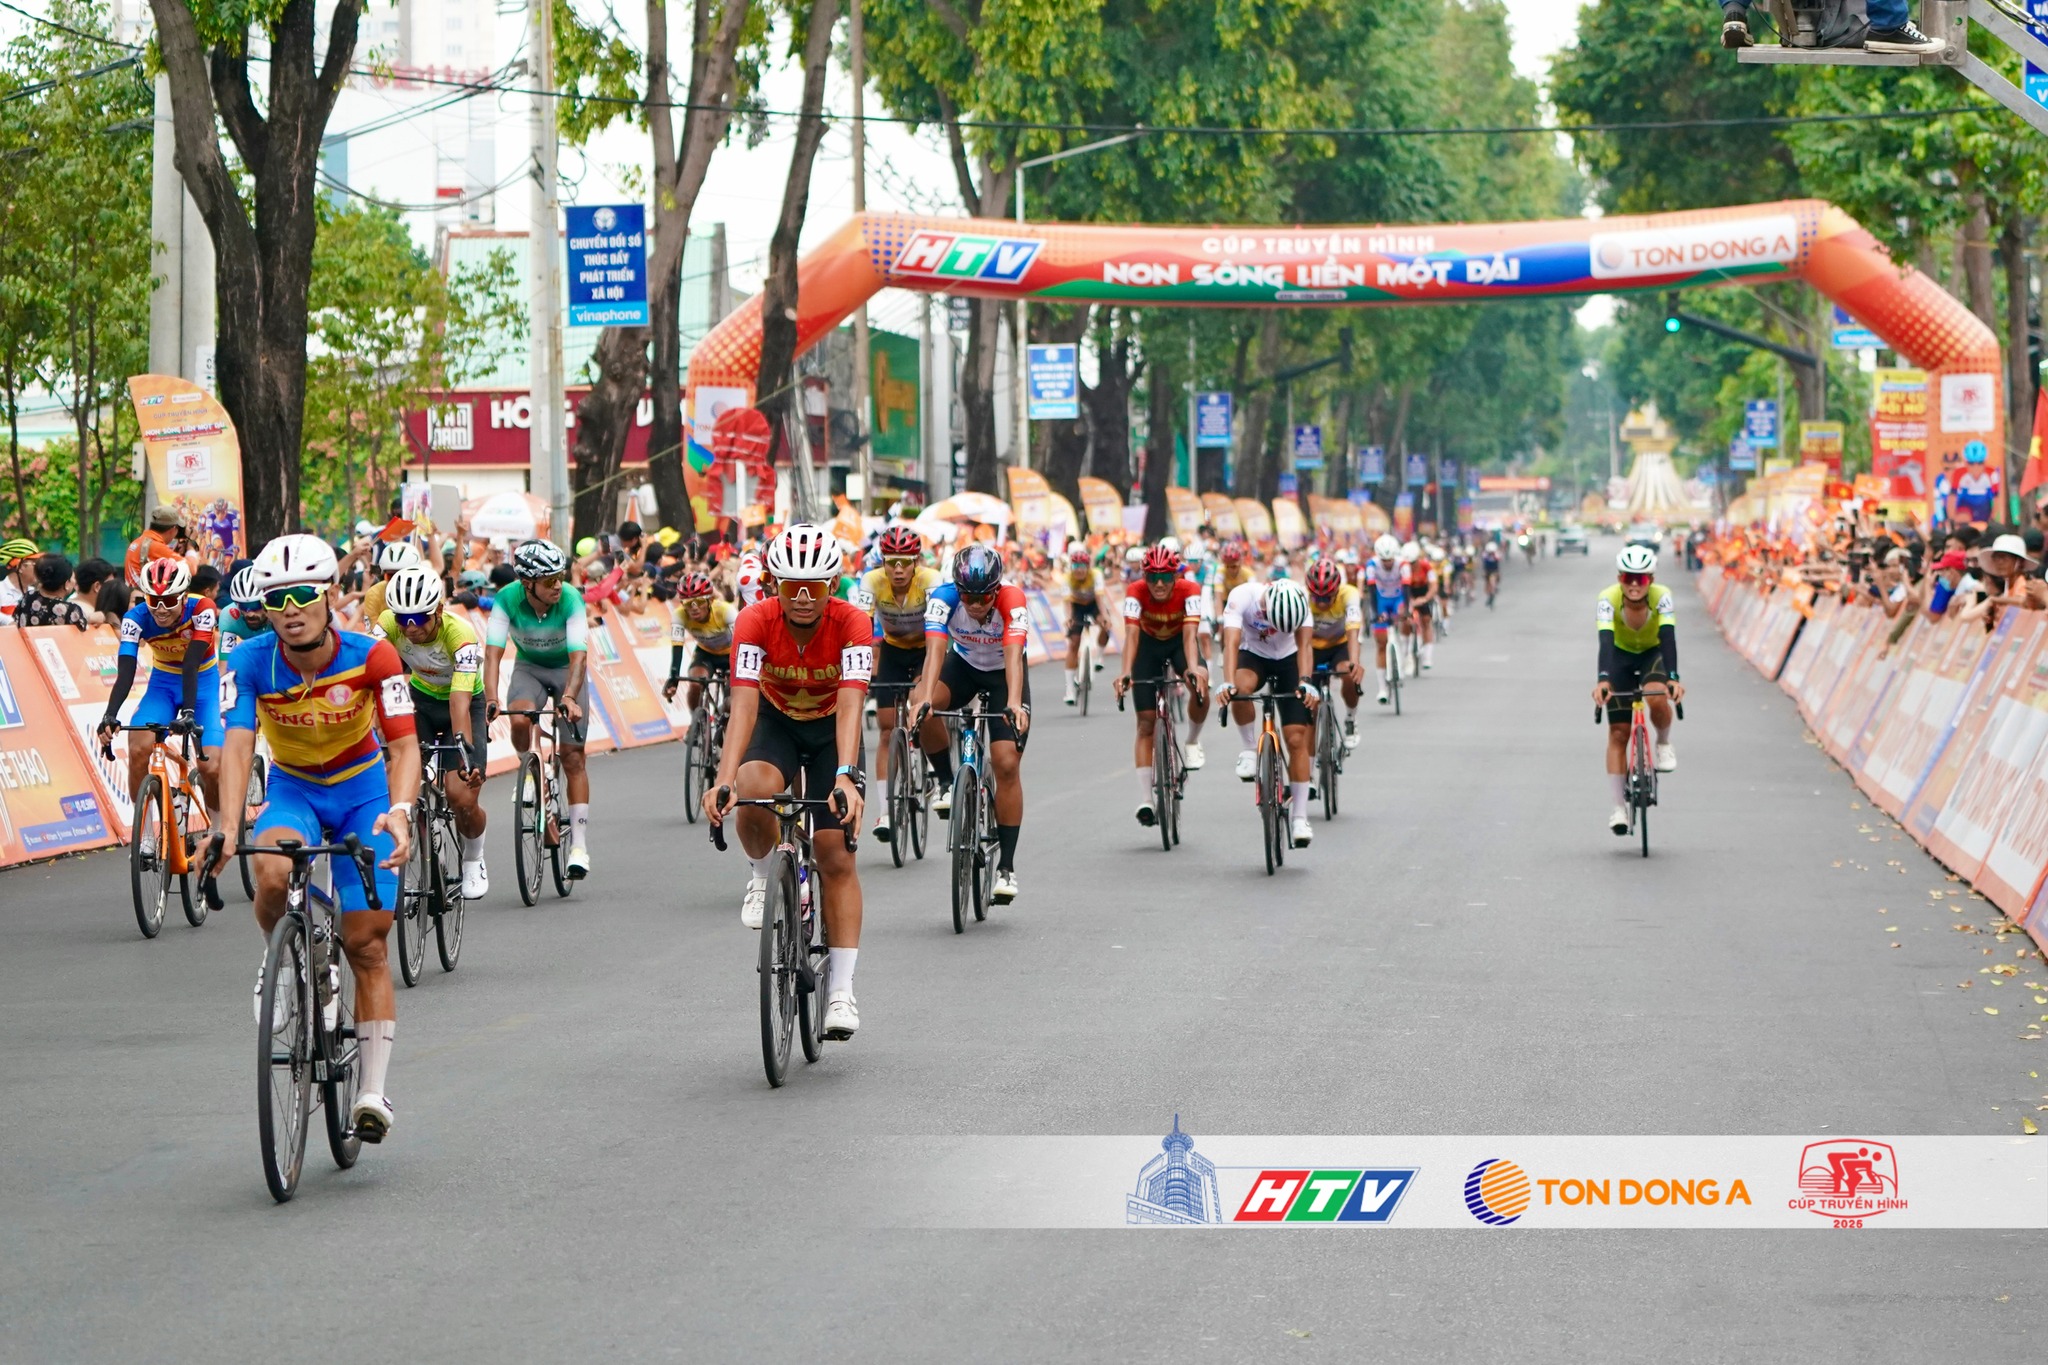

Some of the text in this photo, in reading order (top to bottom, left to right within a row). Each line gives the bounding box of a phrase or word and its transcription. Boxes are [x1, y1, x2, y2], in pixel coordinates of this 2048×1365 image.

[1202, 233, 1435, 254] CÚP TRUYỀN HÌNH
[1632, 234, 1791, 268] TON DONG A
[901, 237, 1026, 275] HTV
[580, 269, 604, 283] PHÁT
[1103, 252, 1520, 290] NON SÔNG LIỀN MỘT DẢI
[576, 309, 642, 323] vinaphone
[122, 621, 138, 636] 32
[845, 651, 872, 671] 112
